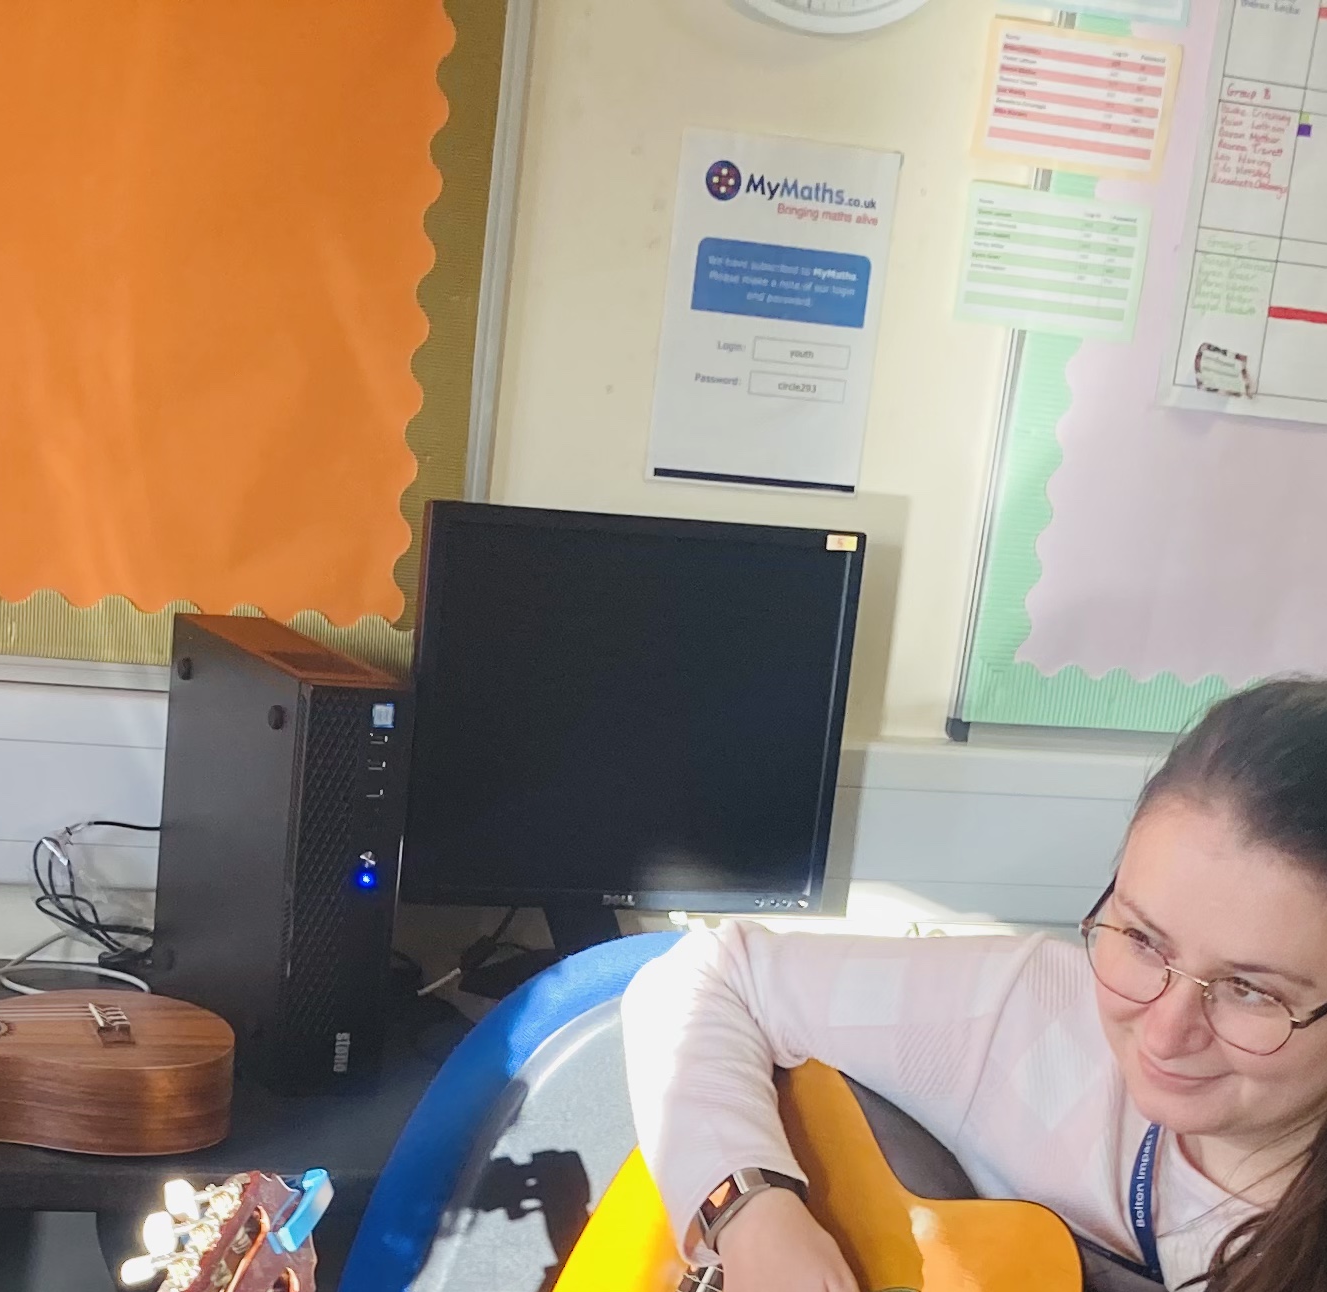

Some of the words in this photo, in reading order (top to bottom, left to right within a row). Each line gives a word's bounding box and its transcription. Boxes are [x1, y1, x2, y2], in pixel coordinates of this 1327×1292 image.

[745, 173, 877, 210] MyMaths.co.uk
[777, 202, 819, 222] Bringing
[821, 210, 852, 223] maths
[855, 213, 878, 226] alive
[1134, 1183, 1146, 1228] Bolton
